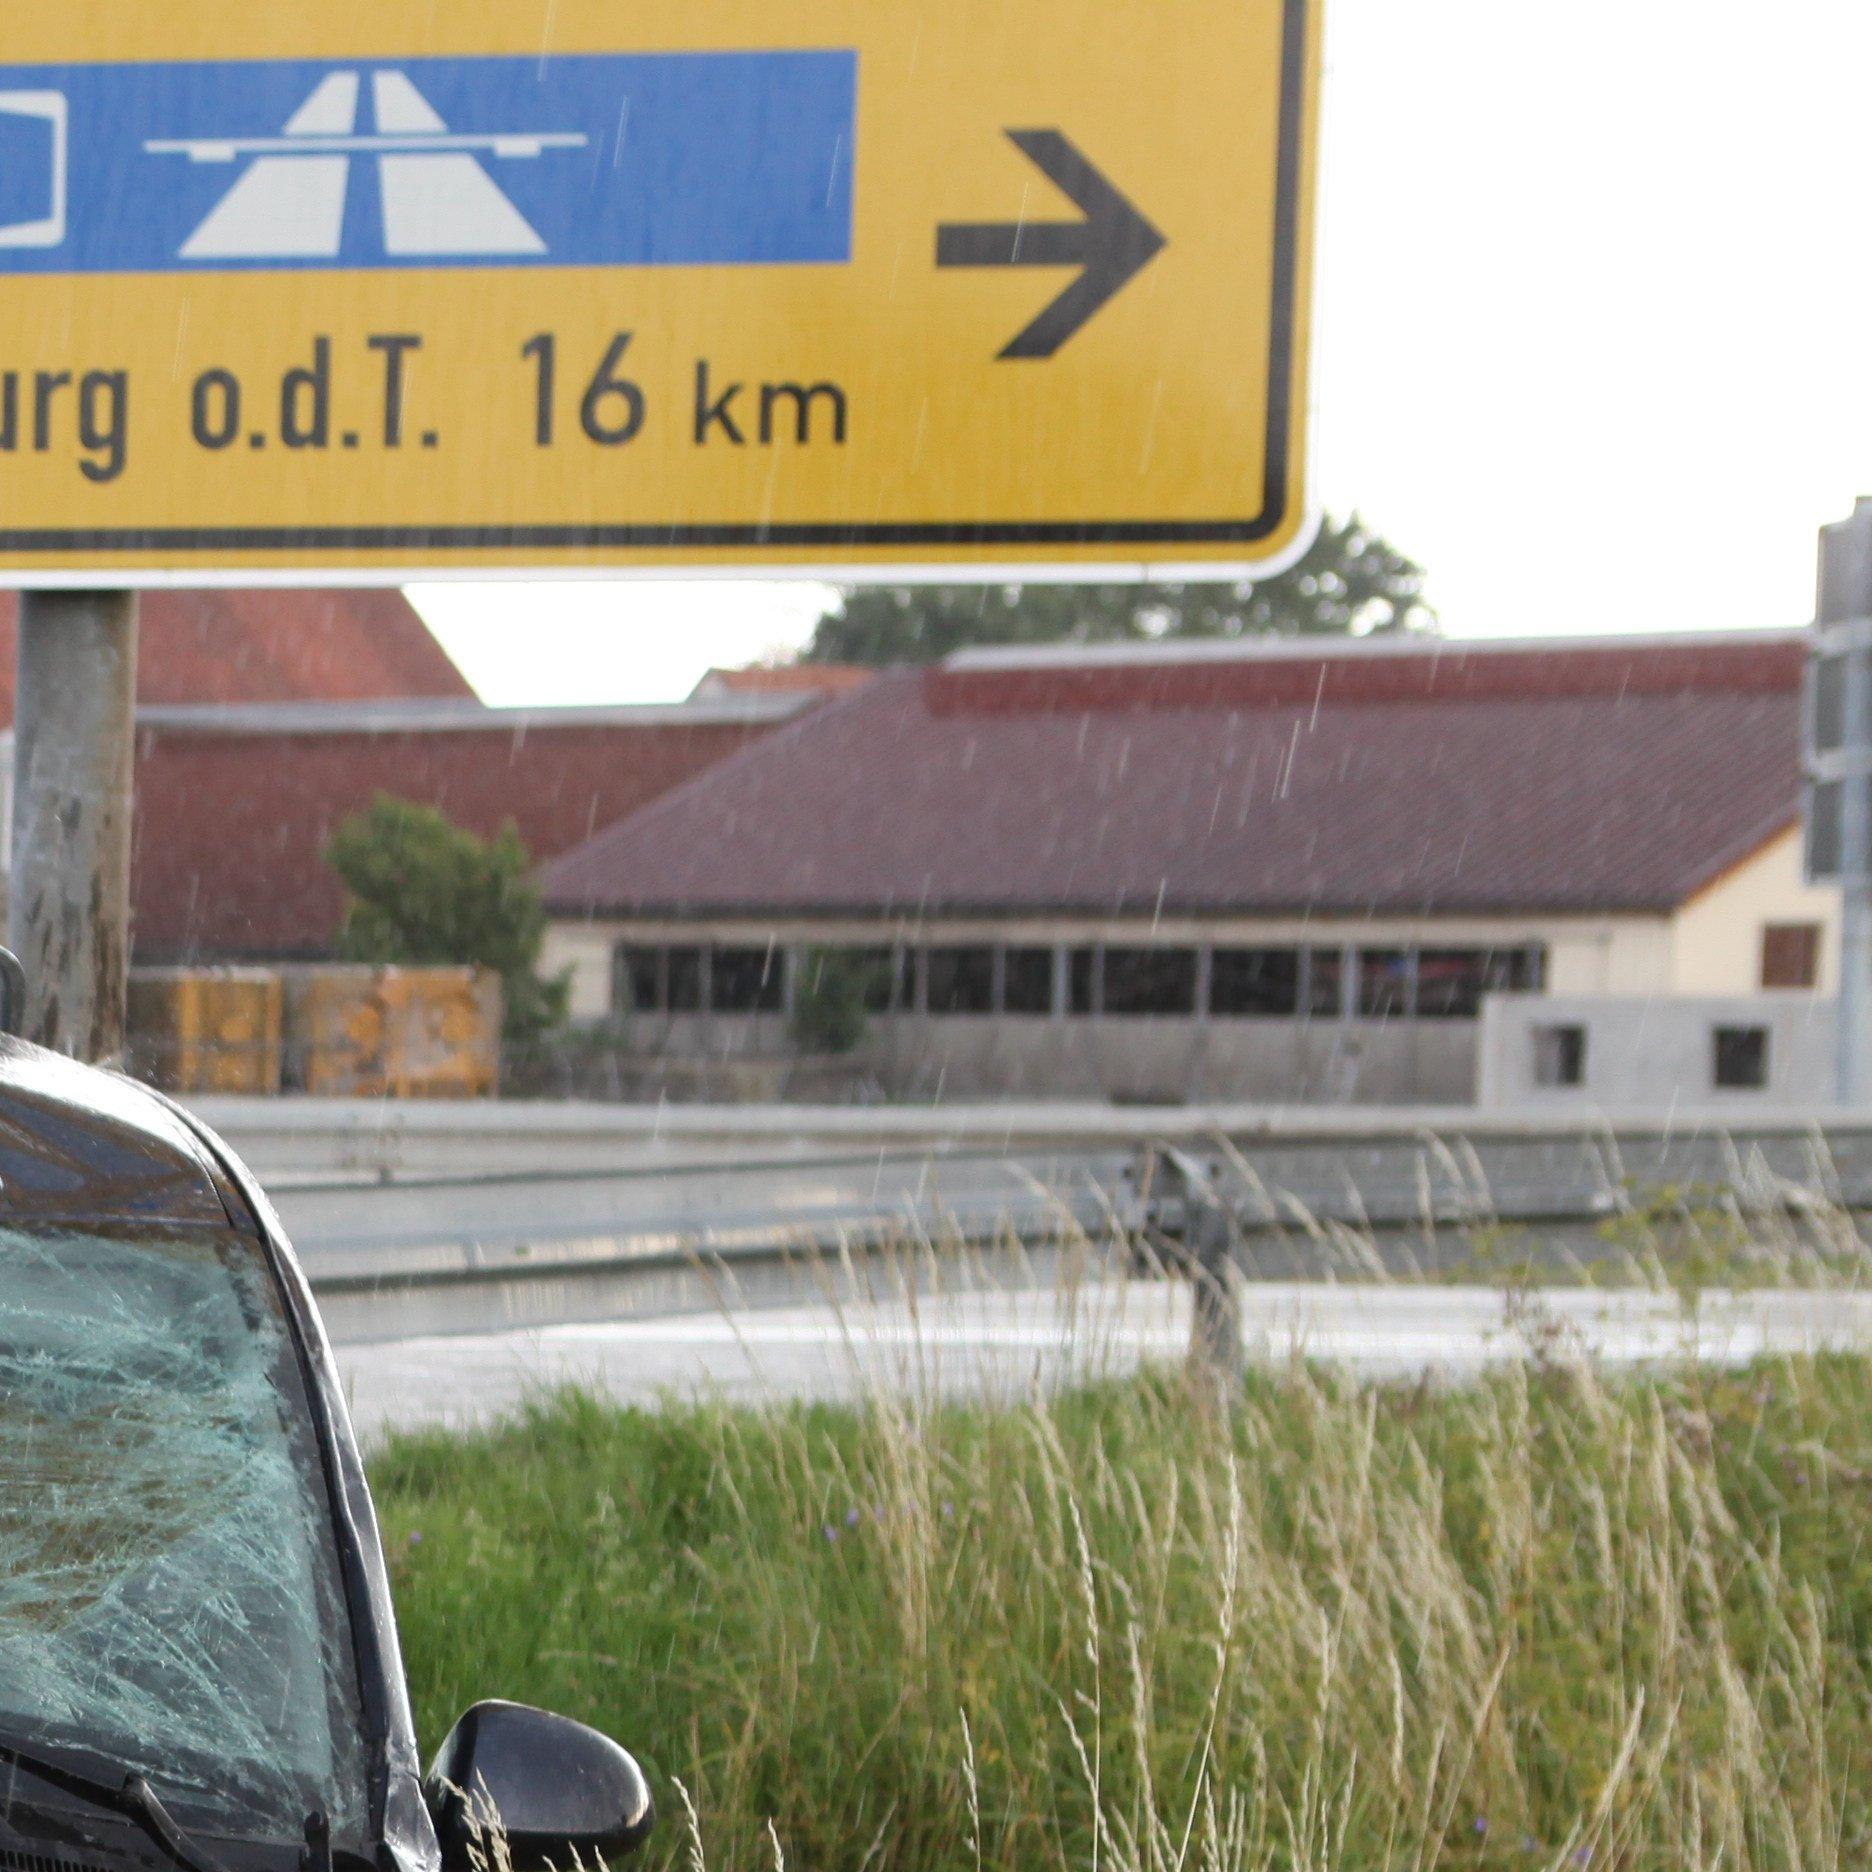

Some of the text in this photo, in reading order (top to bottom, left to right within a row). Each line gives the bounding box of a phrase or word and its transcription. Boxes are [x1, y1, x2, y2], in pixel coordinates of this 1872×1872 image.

[190, 335, 438, 449] o.d.T.
[522, 331, 646, 447] 16
[692, 359, 848, 446] km
